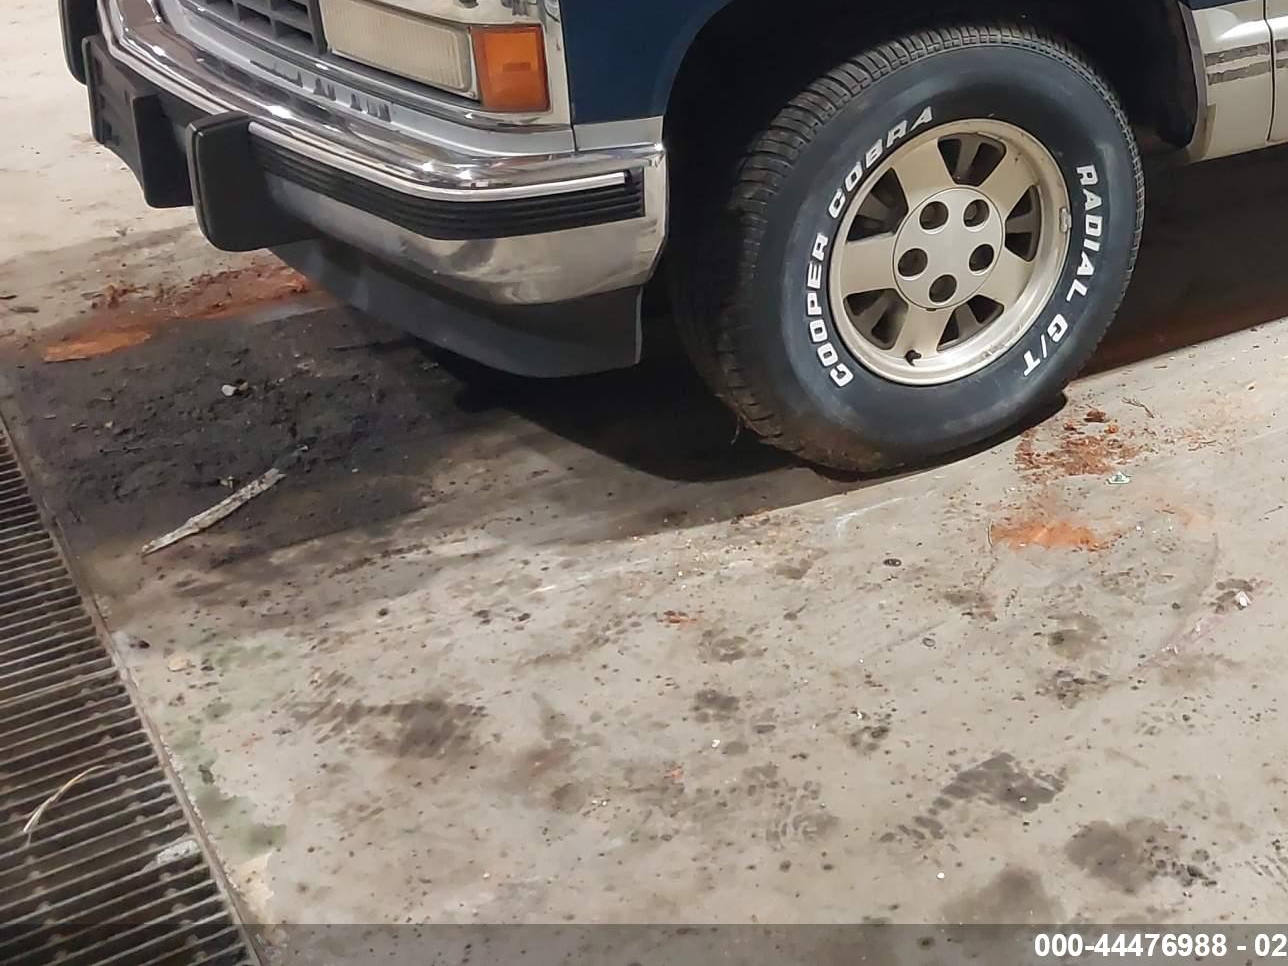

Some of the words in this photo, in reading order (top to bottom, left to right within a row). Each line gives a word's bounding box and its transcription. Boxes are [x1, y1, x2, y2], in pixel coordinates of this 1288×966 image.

[828, 105, 933, 219] COBRA
[1066, 165, 1103, 302] RADIAL
[807, 233, 854, 387] COOPER
[1023, 313, 1069, 377] G/T
